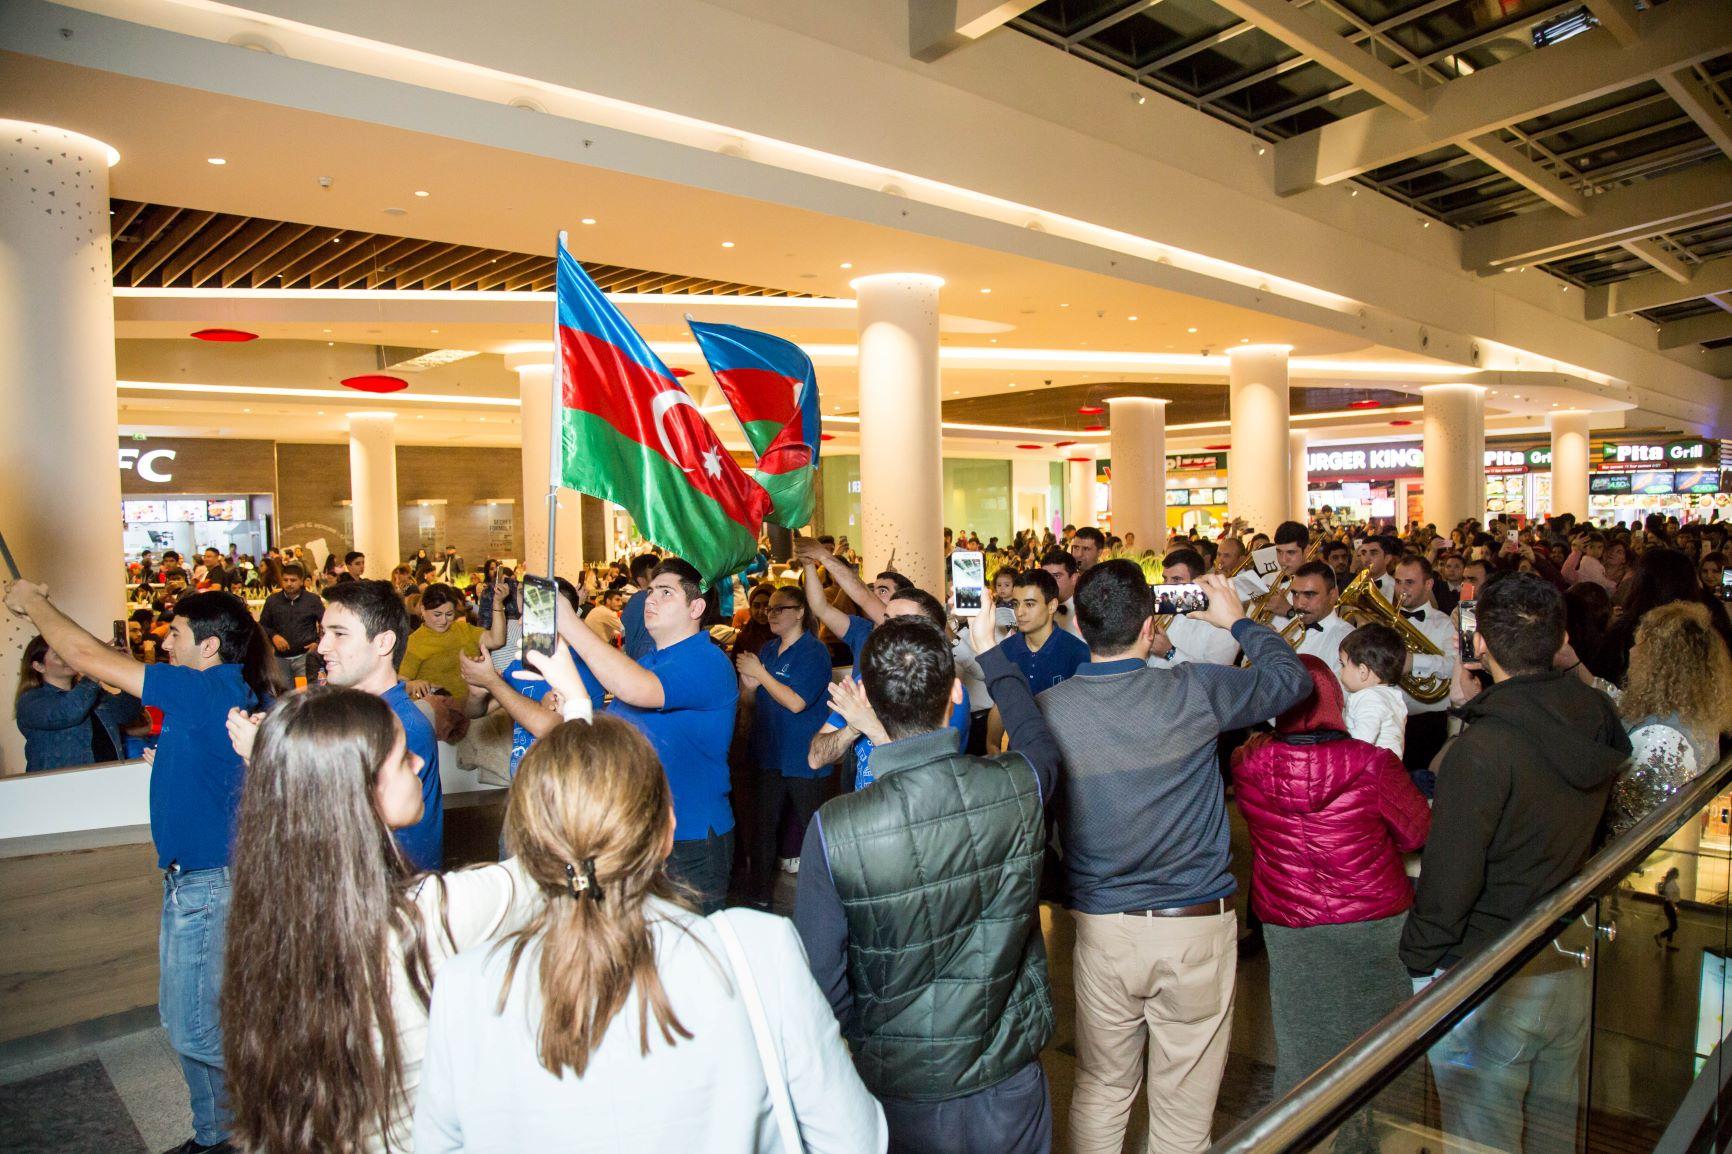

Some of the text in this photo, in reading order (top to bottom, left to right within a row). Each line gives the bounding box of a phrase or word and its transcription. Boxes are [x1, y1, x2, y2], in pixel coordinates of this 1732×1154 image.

[1370, 448, 1421, 469] KING
[1484, 451, 1525, 466] Pita
[1617, 445, 1664, 461] Pita
[1670, 444, 1703, 459] Grill
